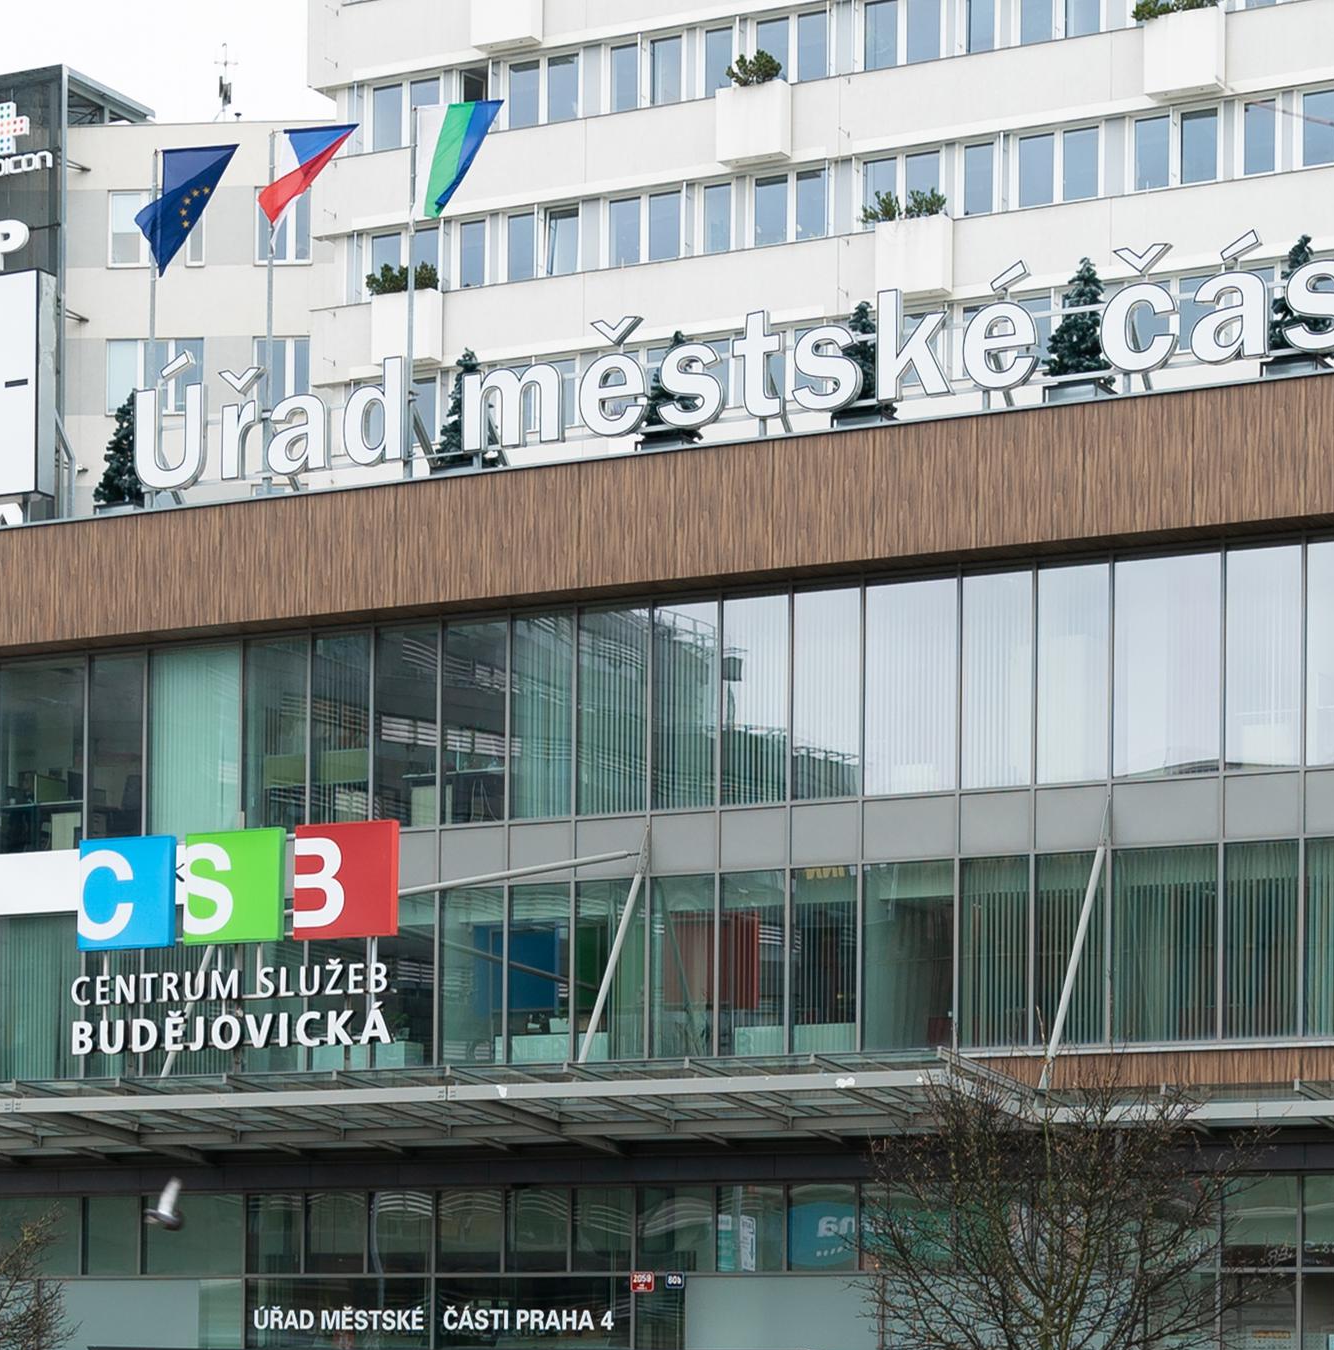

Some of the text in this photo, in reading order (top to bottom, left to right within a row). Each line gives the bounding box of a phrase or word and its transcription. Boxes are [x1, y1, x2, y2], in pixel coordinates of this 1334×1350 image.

[134, 350, 406, 491] Úřad
[462, 260, 1042, 452] městské
[78, 836, 347, 942] CSB
[71, 958, 390, 1007] CENTRUM SLUŽEB
[71, 1002, 393, 1057] BUDĚJOVICKÁ
[253, 1306, 615, 1331] ÚŘAD MĚSTSKÉ ČÁSTI PRAHA 4
